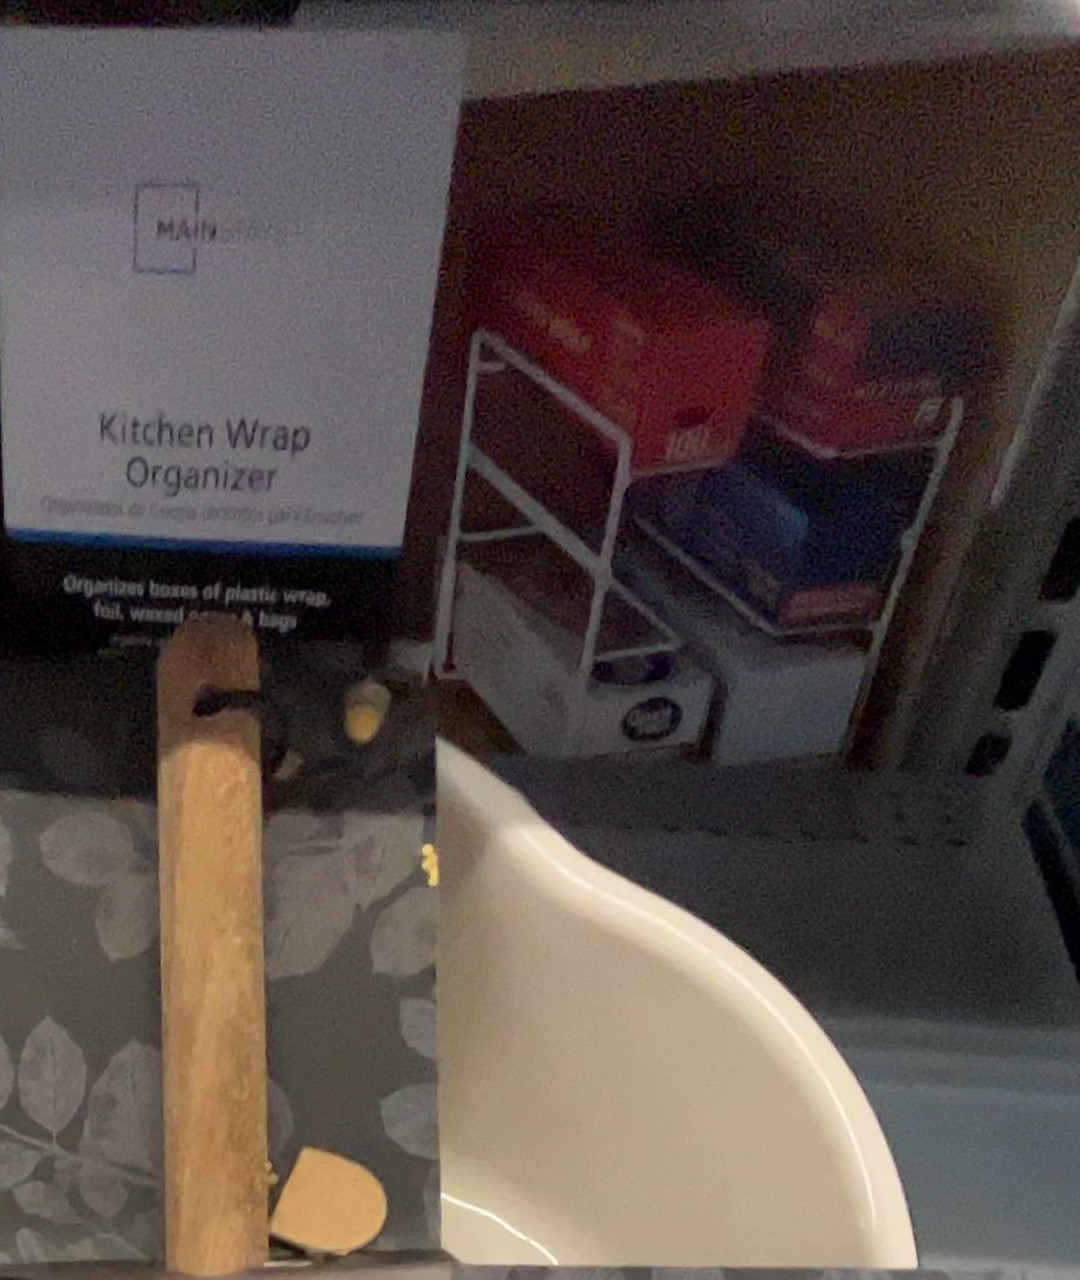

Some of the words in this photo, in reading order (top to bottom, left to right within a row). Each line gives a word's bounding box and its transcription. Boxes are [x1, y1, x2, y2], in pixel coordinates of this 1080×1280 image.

[99, 411, 215, 445] Kitchen
[225, 417, 311, 454] Wrap
[125, 456, 278, 497] Organizer
[149, 578, 198, 599] boxes
[202, 581, 222, 601] of
[224, 582, 278, 606] plastic
[93, 600, 124, 622] foil,
[130, 606, 185, 625] waxed
[259, 611, 298, 634] bags
